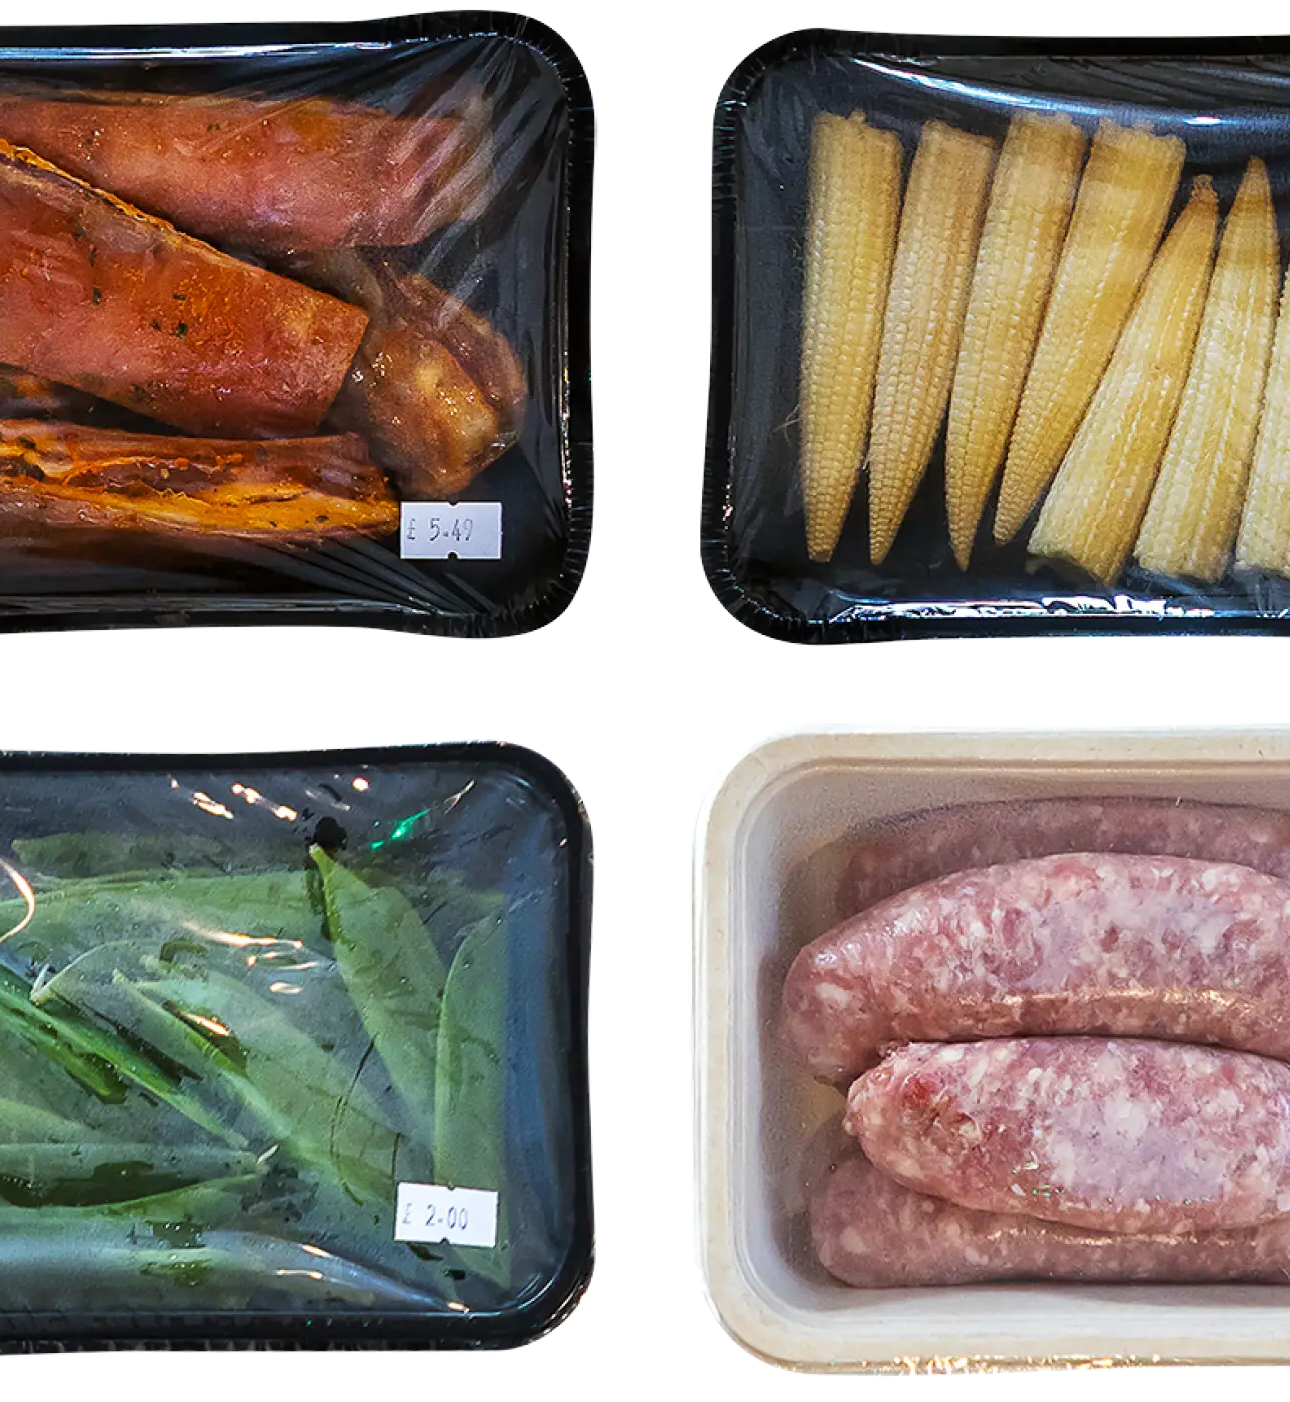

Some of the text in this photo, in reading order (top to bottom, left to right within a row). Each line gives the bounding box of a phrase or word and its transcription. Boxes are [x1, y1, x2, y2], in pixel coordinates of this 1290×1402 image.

[406, 517, 474, 542] £ 5.49
[425, 1204, 469, 1230] 2.00
